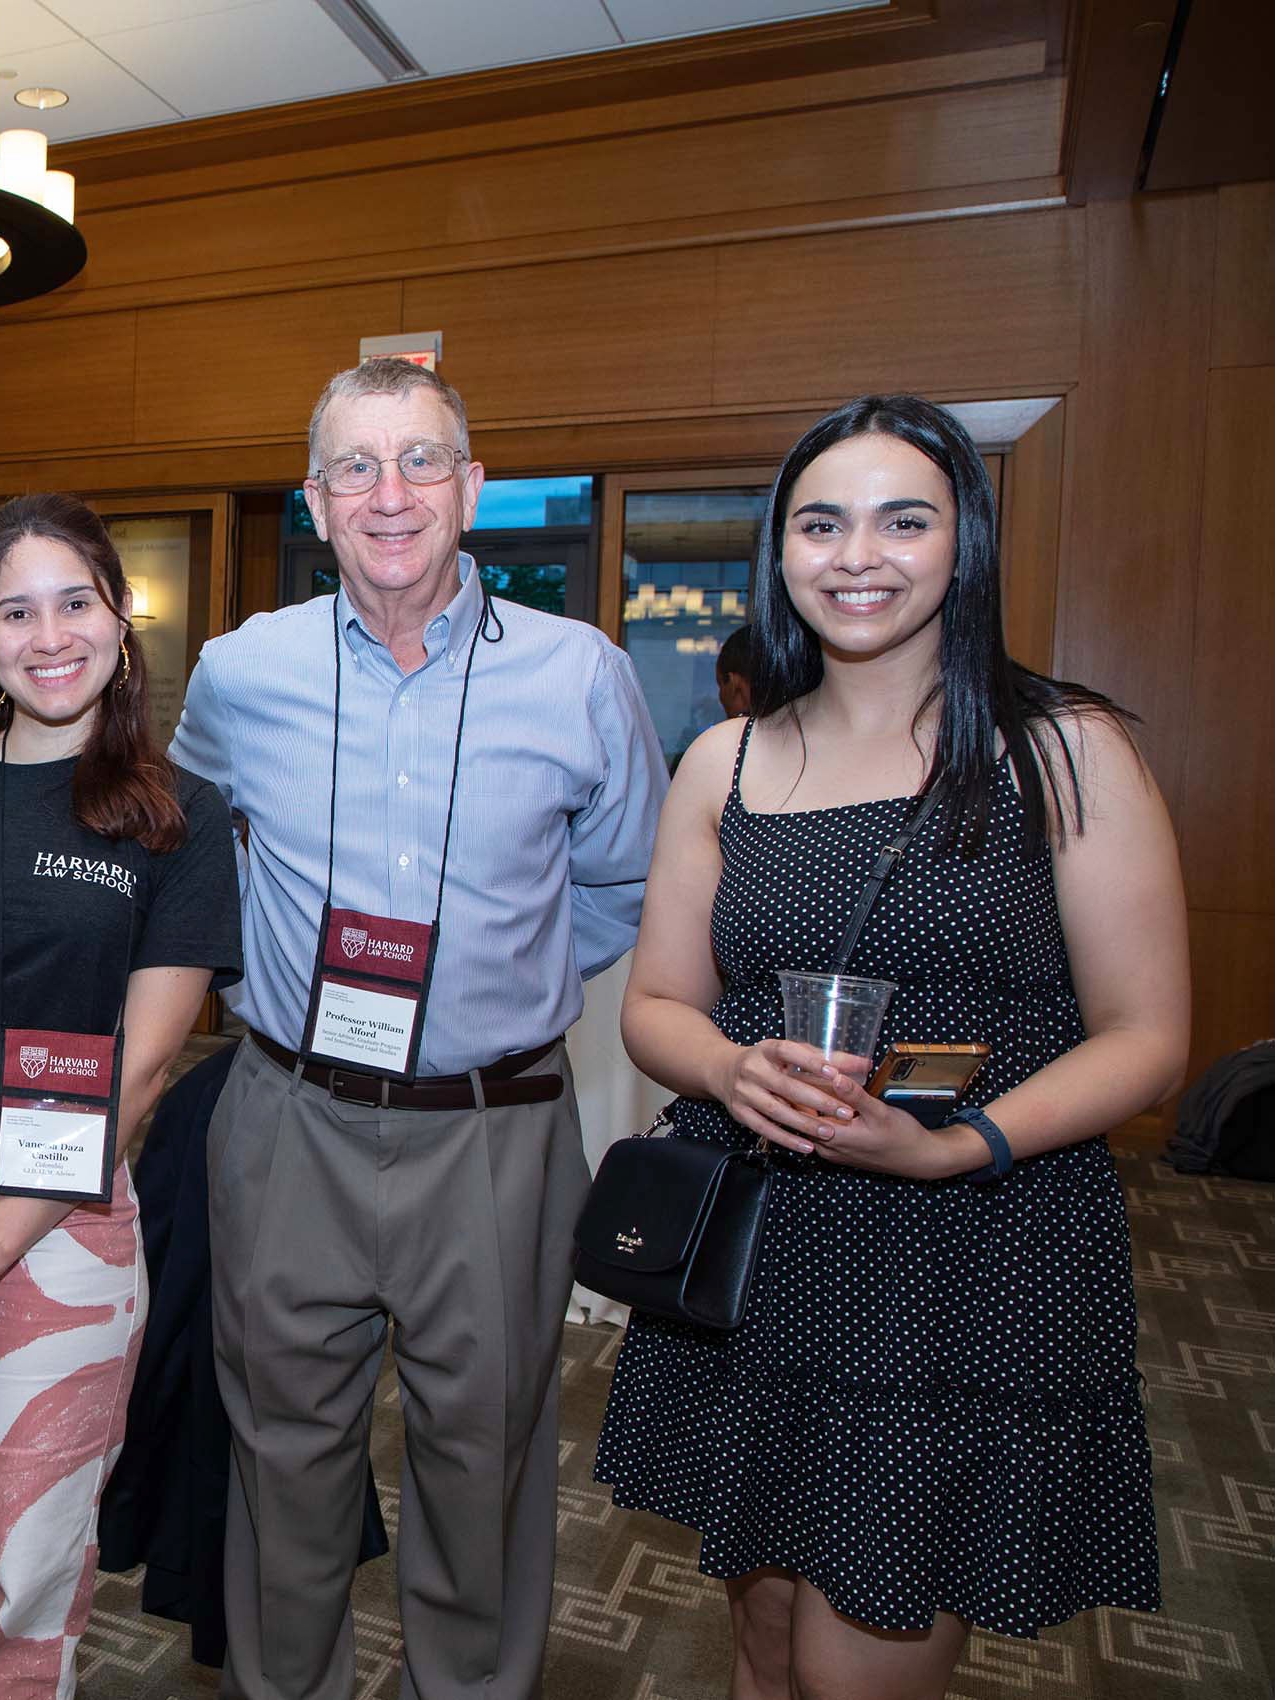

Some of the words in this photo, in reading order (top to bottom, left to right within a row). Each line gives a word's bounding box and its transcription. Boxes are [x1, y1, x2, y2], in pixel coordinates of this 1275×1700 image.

[35, 851, 137, 886] HARVARD
[33, 866, 68, 878] LAW
[72, 870, 133, 898] SCHOOL
[368, 938, 414, 955] HARVARD
[366, 948, 381, 957] LAW
[383, 951, 412, 962] SCHOOL
[324, 1010, 367, 1026] Professor
[368, 1020, 405, 1035] William
[347, 1026, 377, 1039] Alford
[49, 1056, 99, 1070] HARVARD
[49, 1066, 66, 1074] LAW
[67, 1067, 98, 1078] SCHOOL
[18, 1138, 58, 1151] Vanea
[60, 1143, 84, 1153] Daza
